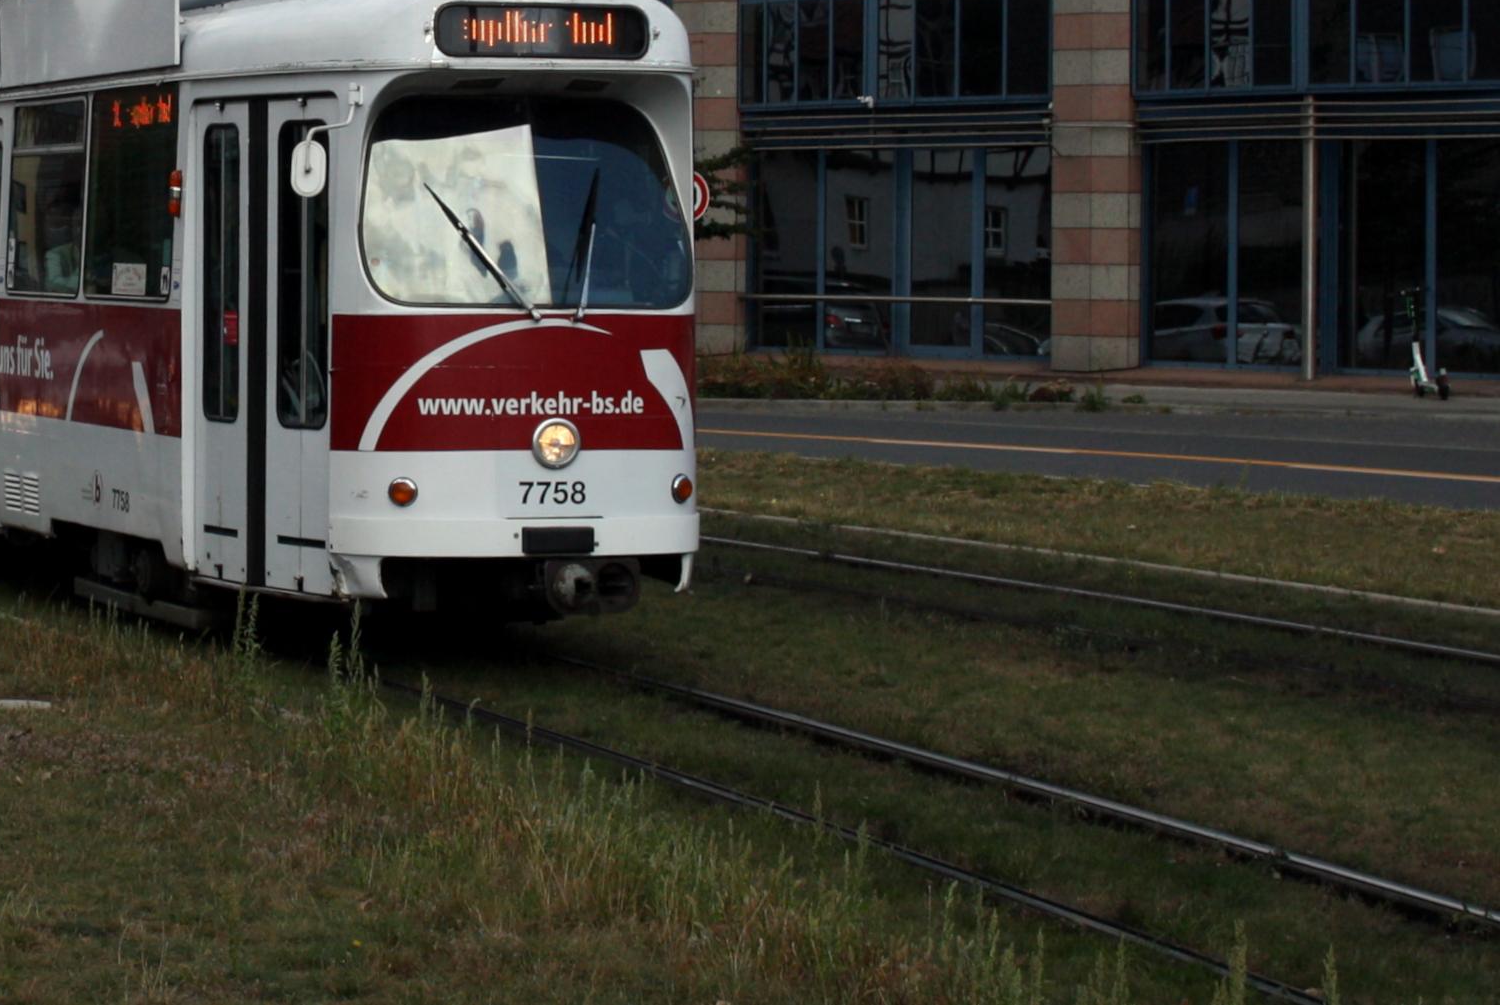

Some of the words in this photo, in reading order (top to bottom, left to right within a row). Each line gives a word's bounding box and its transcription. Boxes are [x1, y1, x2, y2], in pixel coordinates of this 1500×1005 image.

[16, 334, 32, 377] für
[34, 337, 54, 380] Sie.
[418, 390, 644, 417] www.verkehr-bs.de
[111, 487, 131, 514] 7758
[518, 480, 586, 505] 7758
